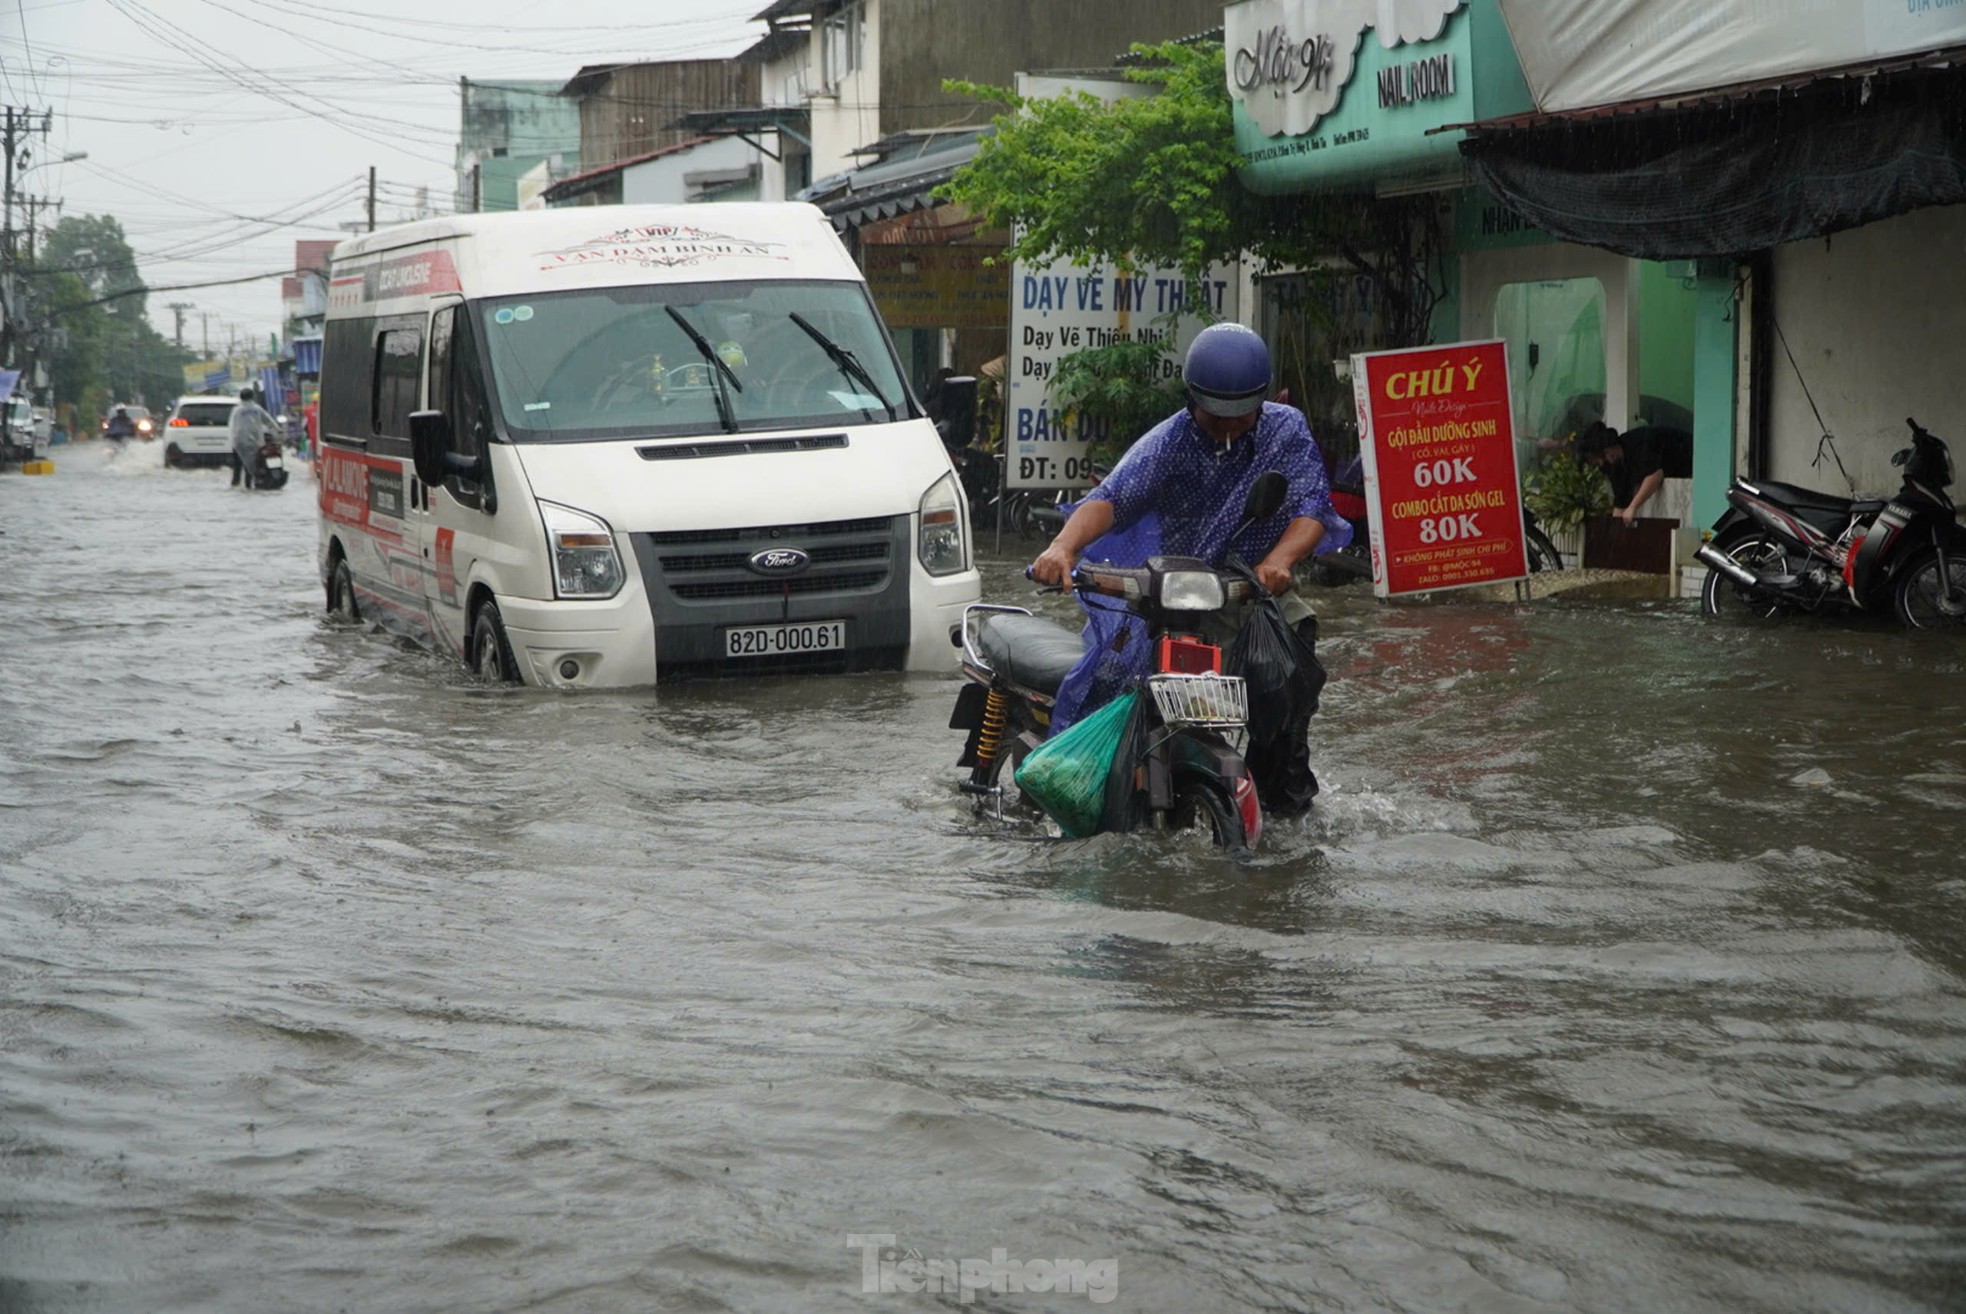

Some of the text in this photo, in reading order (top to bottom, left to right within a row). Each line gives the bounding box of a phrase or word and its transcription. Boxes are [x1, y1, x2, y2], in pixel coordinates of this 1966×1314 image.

[1377, 54, 1452, 108] NAIL ROOM
[645, 227, 672, 236] VIP
[740, 246, 769, 254] AN
[1023, 275, 1068, 317] DẠY
[1076, 269, 1103, 311] VẼ
[1023, 325, 1164, 351] Dạy Vẽ Thiếu Nhi
[1022, 356, 1052, 381] Dạy
[1385, 360, 1455, 400] CHÚ
[1462, 356, 1483, 391] Ý
[1017, 399, 1067, 441] BÁN
[1388, 419, 1496, 450] GỘI ĐẦU DƯỠNG SINH
[1020, 457, 1056, 480] ĐT:
[1414, 456, 1477, 488] 60K
[1392, 489, 1505, 519] COMBO CẮT DA SƠN GEL
[1419, 512, 1482, 543] 80K
[764, 552, 797, 567] Ford
[1403, 541, 1507, 564] KHÔNG PHÁT SINH CHI PHÍ
[729, 624, 840, 654] 82D-000.61
